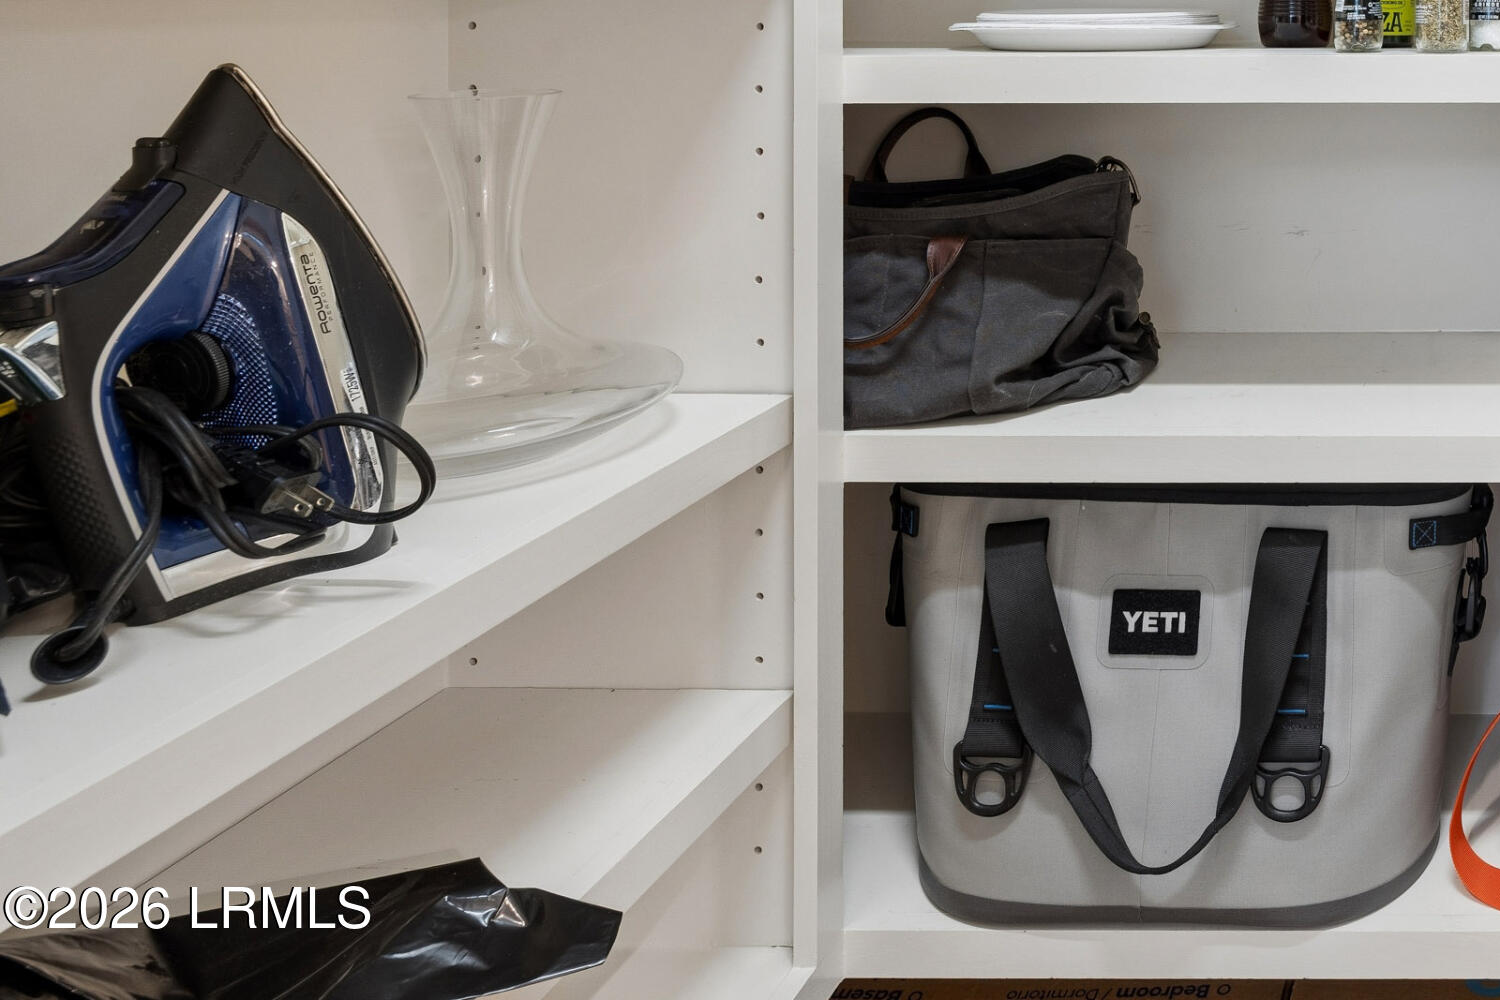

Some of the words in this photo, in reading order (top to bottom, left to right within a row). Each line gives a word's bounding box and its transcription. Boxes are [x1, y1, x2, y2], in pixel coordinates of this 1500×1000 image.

[309, 251, 334, 322] PERFORMANCE
[1122, 610, 1187, 634] YETI
[1006, 988, 1100, 1000] Dormitorio
[1115, 984, 1210, 998] Bedroom
